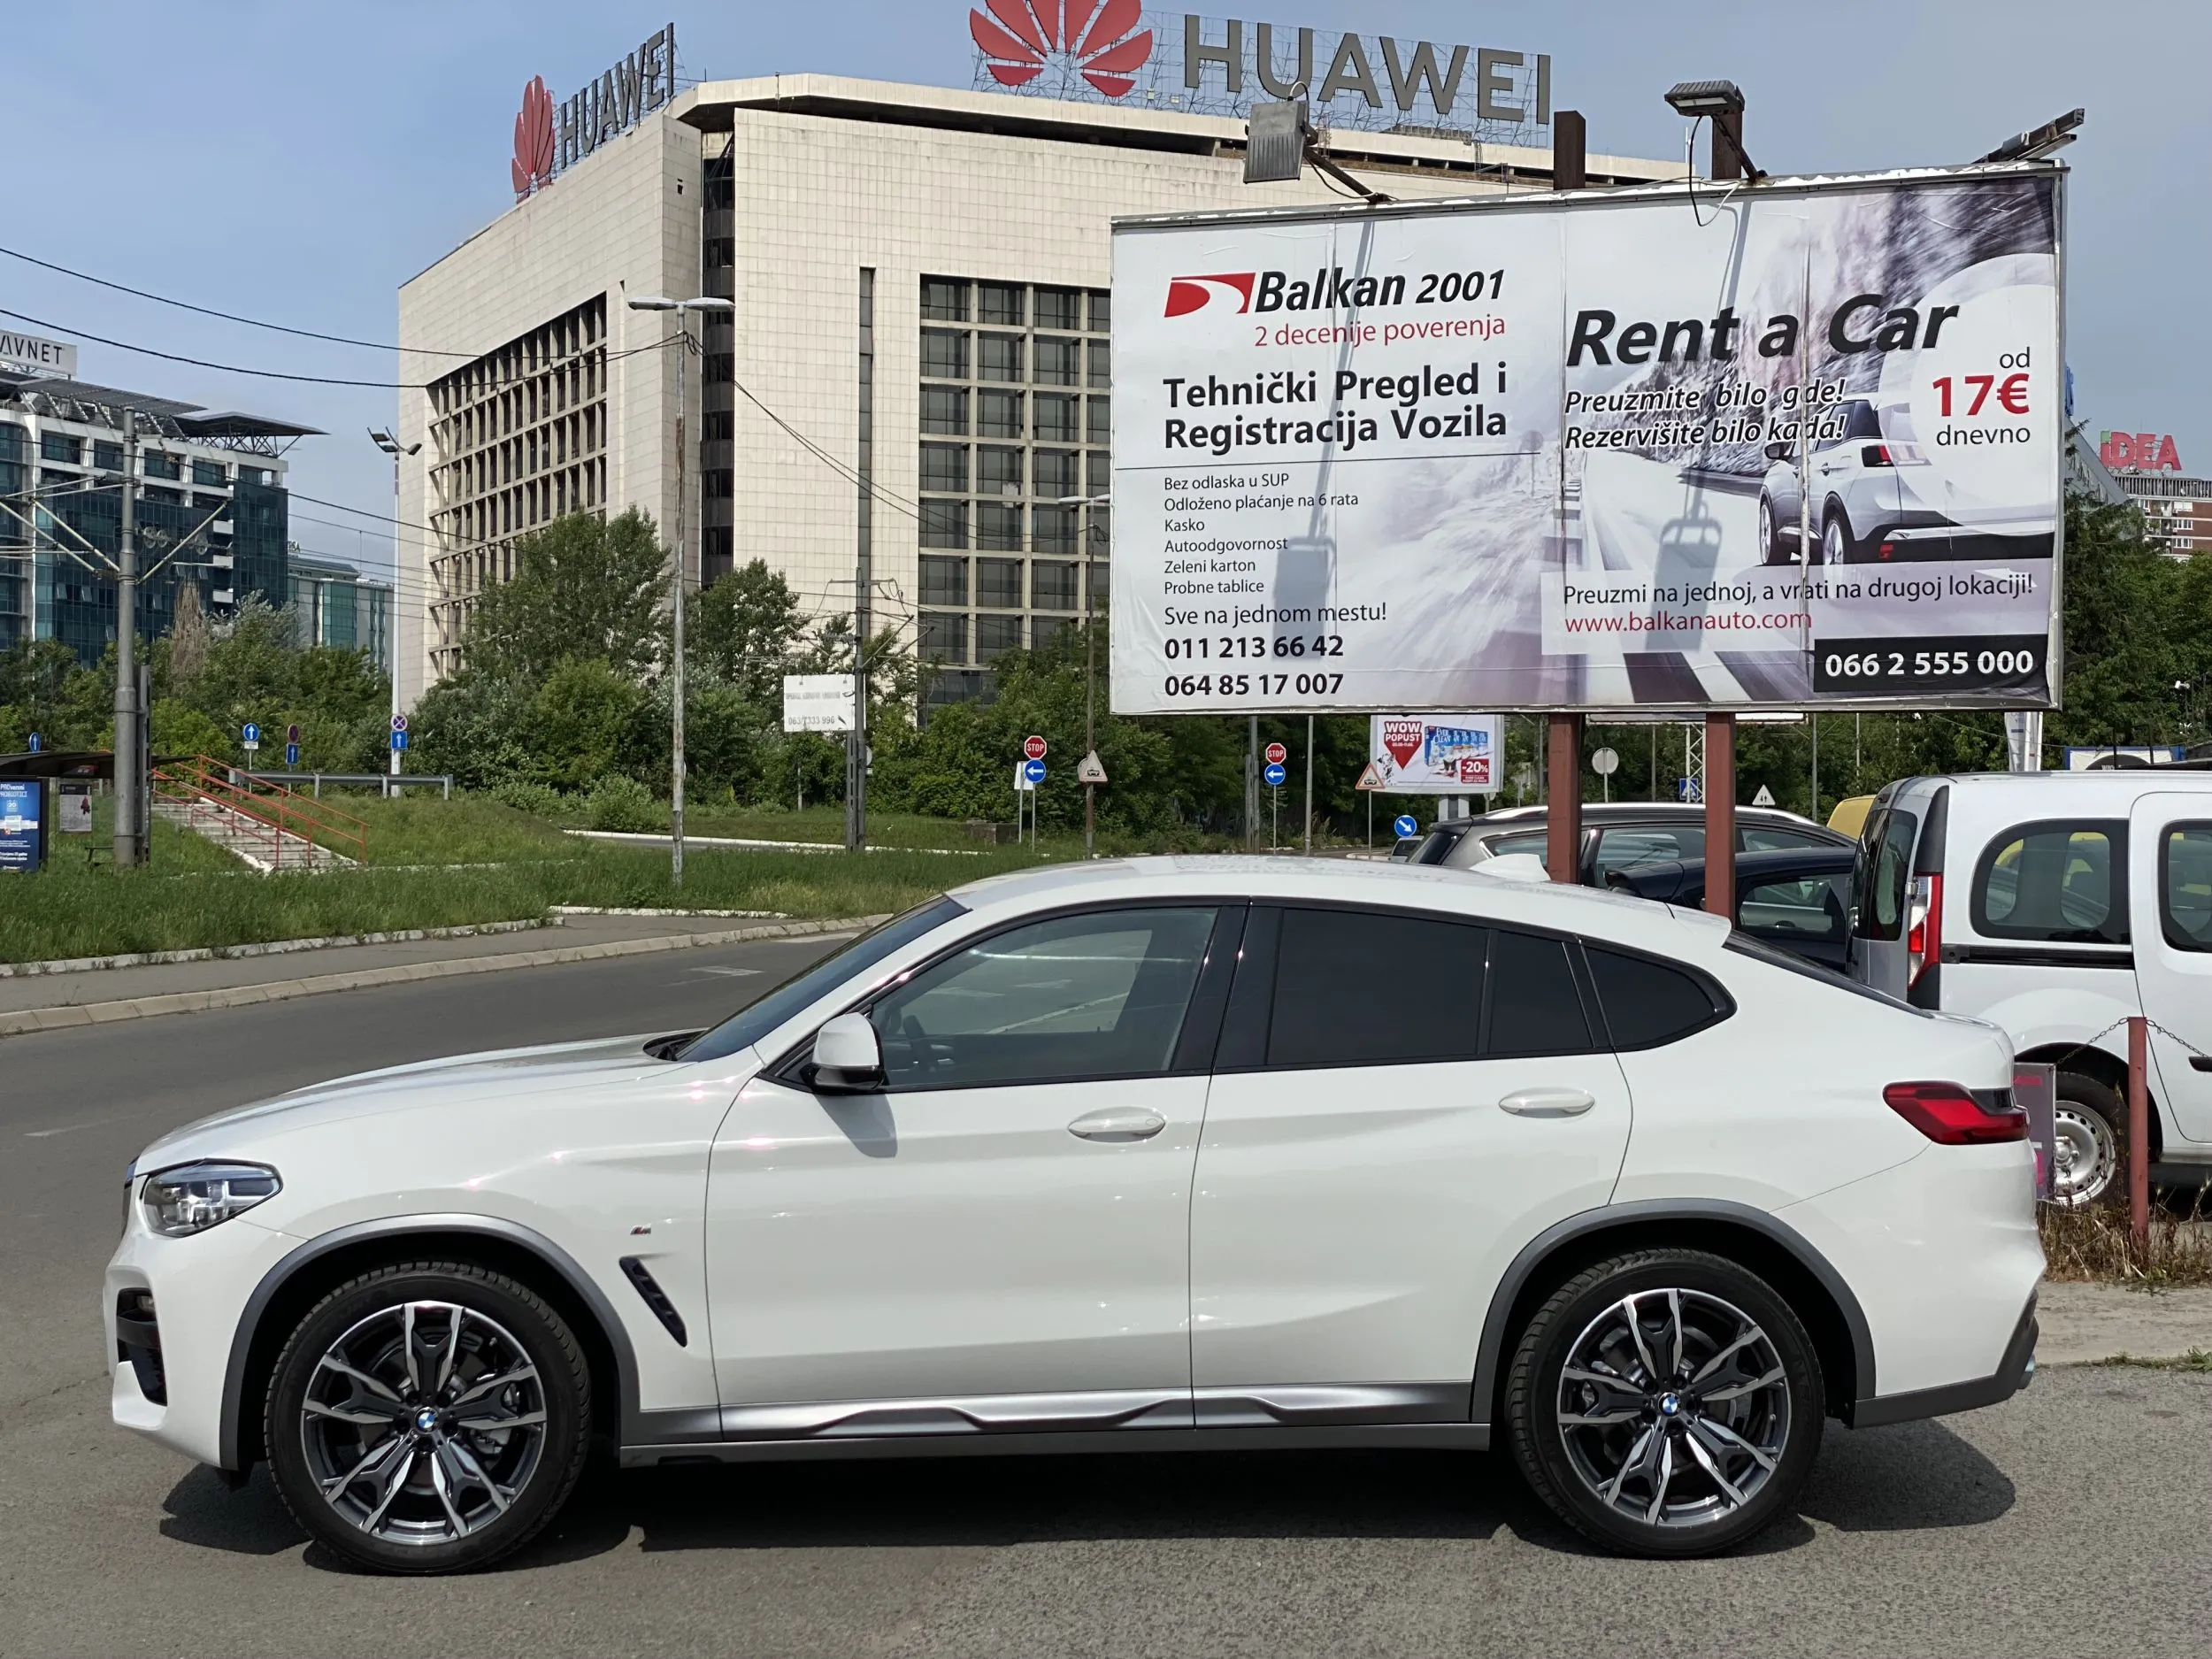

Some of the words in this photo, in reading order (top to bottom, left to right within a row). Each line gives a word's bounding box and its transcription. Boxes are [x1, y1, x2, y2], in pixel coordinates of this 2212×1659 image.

[1185, 14, 1550, 124] HUAWEI
[561, 22, 674, 169] HUAWEI
[1255, 268, 1406, 312] Balkan
[1416, 269, 1504, 303] 2001
[1255, 326, 1267, 346] 2
[1275, 318, 1376, 347] decenije
[1385, 313, 1506, 344] poverenja
[1566, 305, 1740, 367] Rent
[1759, 314, 1798, 357] a
[1829, 294, 1961, 353] Car
[0, 334, 62, 365] AVNET
[1999, 347, 2031, 370] od
[1164, 370, 1316, 407] Tehnički
[1336, 363, 1479, 405] Pregled
[1498, 362, 1506, 393] i
[1932, 373, 2031, 418] 17€
[1565, 380, 1700, 415] Preuzmite
[1716, 381, 1766, 406] bilo
[1165, 412, 1377, 455] Registracija
[1391, 404, 1506, 440] Vozila
[1566, 415, 1705, 449] Rezervišite
[1712, 417, 1762, 443] bilo
[1768, 413, 1847, 441] kada!
[1937, 425, 2031, 447] dnevno
[1164, 477, 1189, 490] Bez
[1193, 475, 1245, 489] odlaska
[1248, 478, 1257, 488] u
[1261, 473, 1289, 487] SUP
[1164, 495, 1232, 511] Odloženo
[1235, 495, 1293, 511] plaćanje
[1297, 497, 1315, 507] na
[1318, 495, 1327, 506] 6
[1331, 495, 1358, 506] rata
[1165, 518, 1204, 532] Kasko
[1164, 537, 1287, 556] Autoodgovornost
[1164, 559, 1207, 574] Zeleni
[1210, 559, 1256, 572] karton
[1164, 580, 1214, 595] Probne
[1217, 580, 1263, 593] tablice
[1563, 585, 1647, 604] Preuzmi
[1653, 588, 1678, 603] na
[1682, 582, 1757, 607] jednoj,
[1763, 587, 1773, 599] a
[1780, 580, 1828, 599] vrati
[1836, 582, 1861, 599] na
[1869, 577, 1941, 602] drugoj
[1949, 574, 2033, 599] lokaciji!
[1164, 606, 1199, 625] Sve
[1203, 609, 1229, 624] na
[1233, 604, 1311, 627] jednom
[1317, 603, 1386, 622] mestu!
[1565, 610, 1812, 634] www.balkanauto.com
[1164, 637, 1210, 659] 011
[1219, 637, 1265, 658] 213
[1273, 636, 1305, 657] 66
[1311, 635, 1344, 657] 42
[1825, 653, 1878, 677] 066
[1887, 653, 1905, 675] 2
[1914, 652, 1969, 674] 555
[1978, 650, 2033, 673] 000
[1164, 676, 1211, 695] 064
[1218, 675, 1248, 695] 85
[1259, 674, 1288, 695] 17
[1295, 673, 1344, 695] 007
[1386, 722, 1420, 733] WOW
[1027, 743, 1044, 752] STOP
[1463, 761, 1488, 772] -20%
